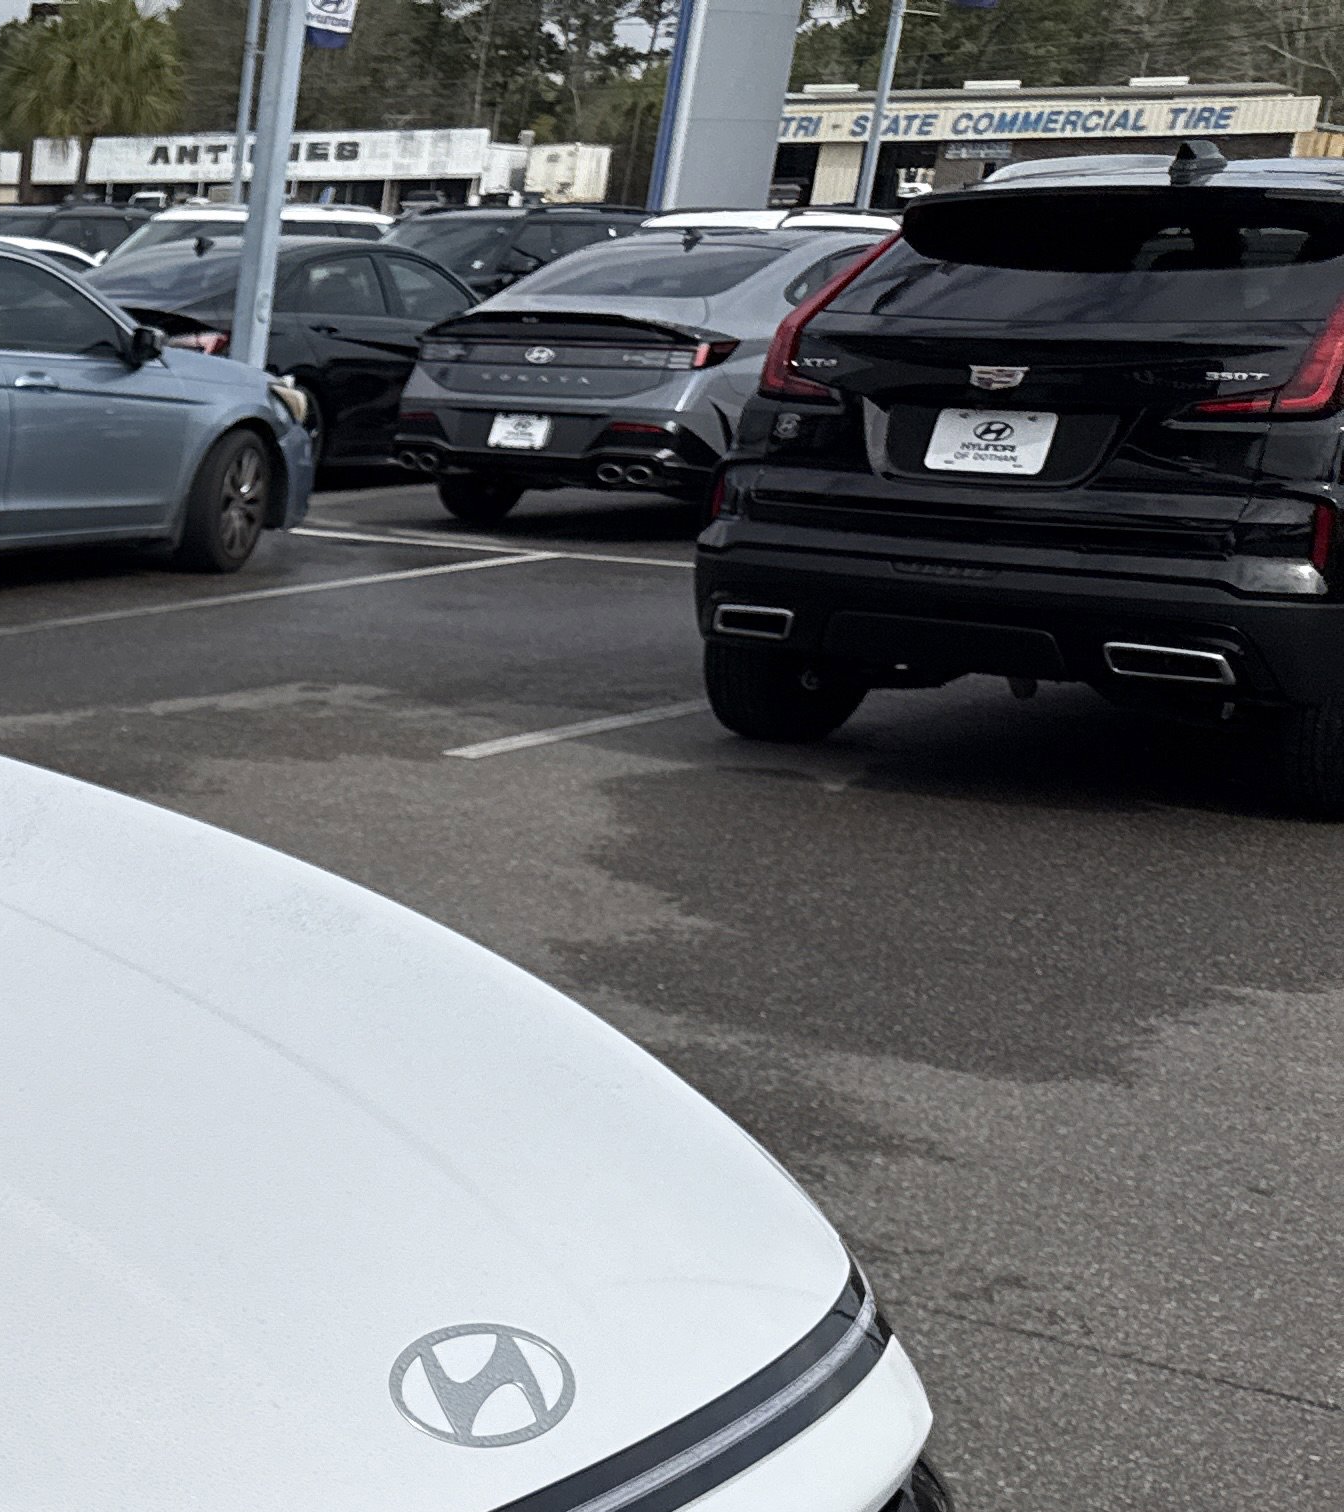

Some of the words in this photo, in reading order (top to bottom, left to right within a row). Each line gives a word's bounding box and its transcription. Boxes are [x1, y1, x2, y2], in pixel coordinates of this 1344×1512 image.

[780, 115, 823, 137] TRI
[849, 113, 939, 137] SATE
[951, 107, 1148, 135] COMMERCIAL
[1167, 105, 1238, 130] TIRE
[149, 142, 360, 164] ANTES
[1205, 371, 1270, 381] 350T
